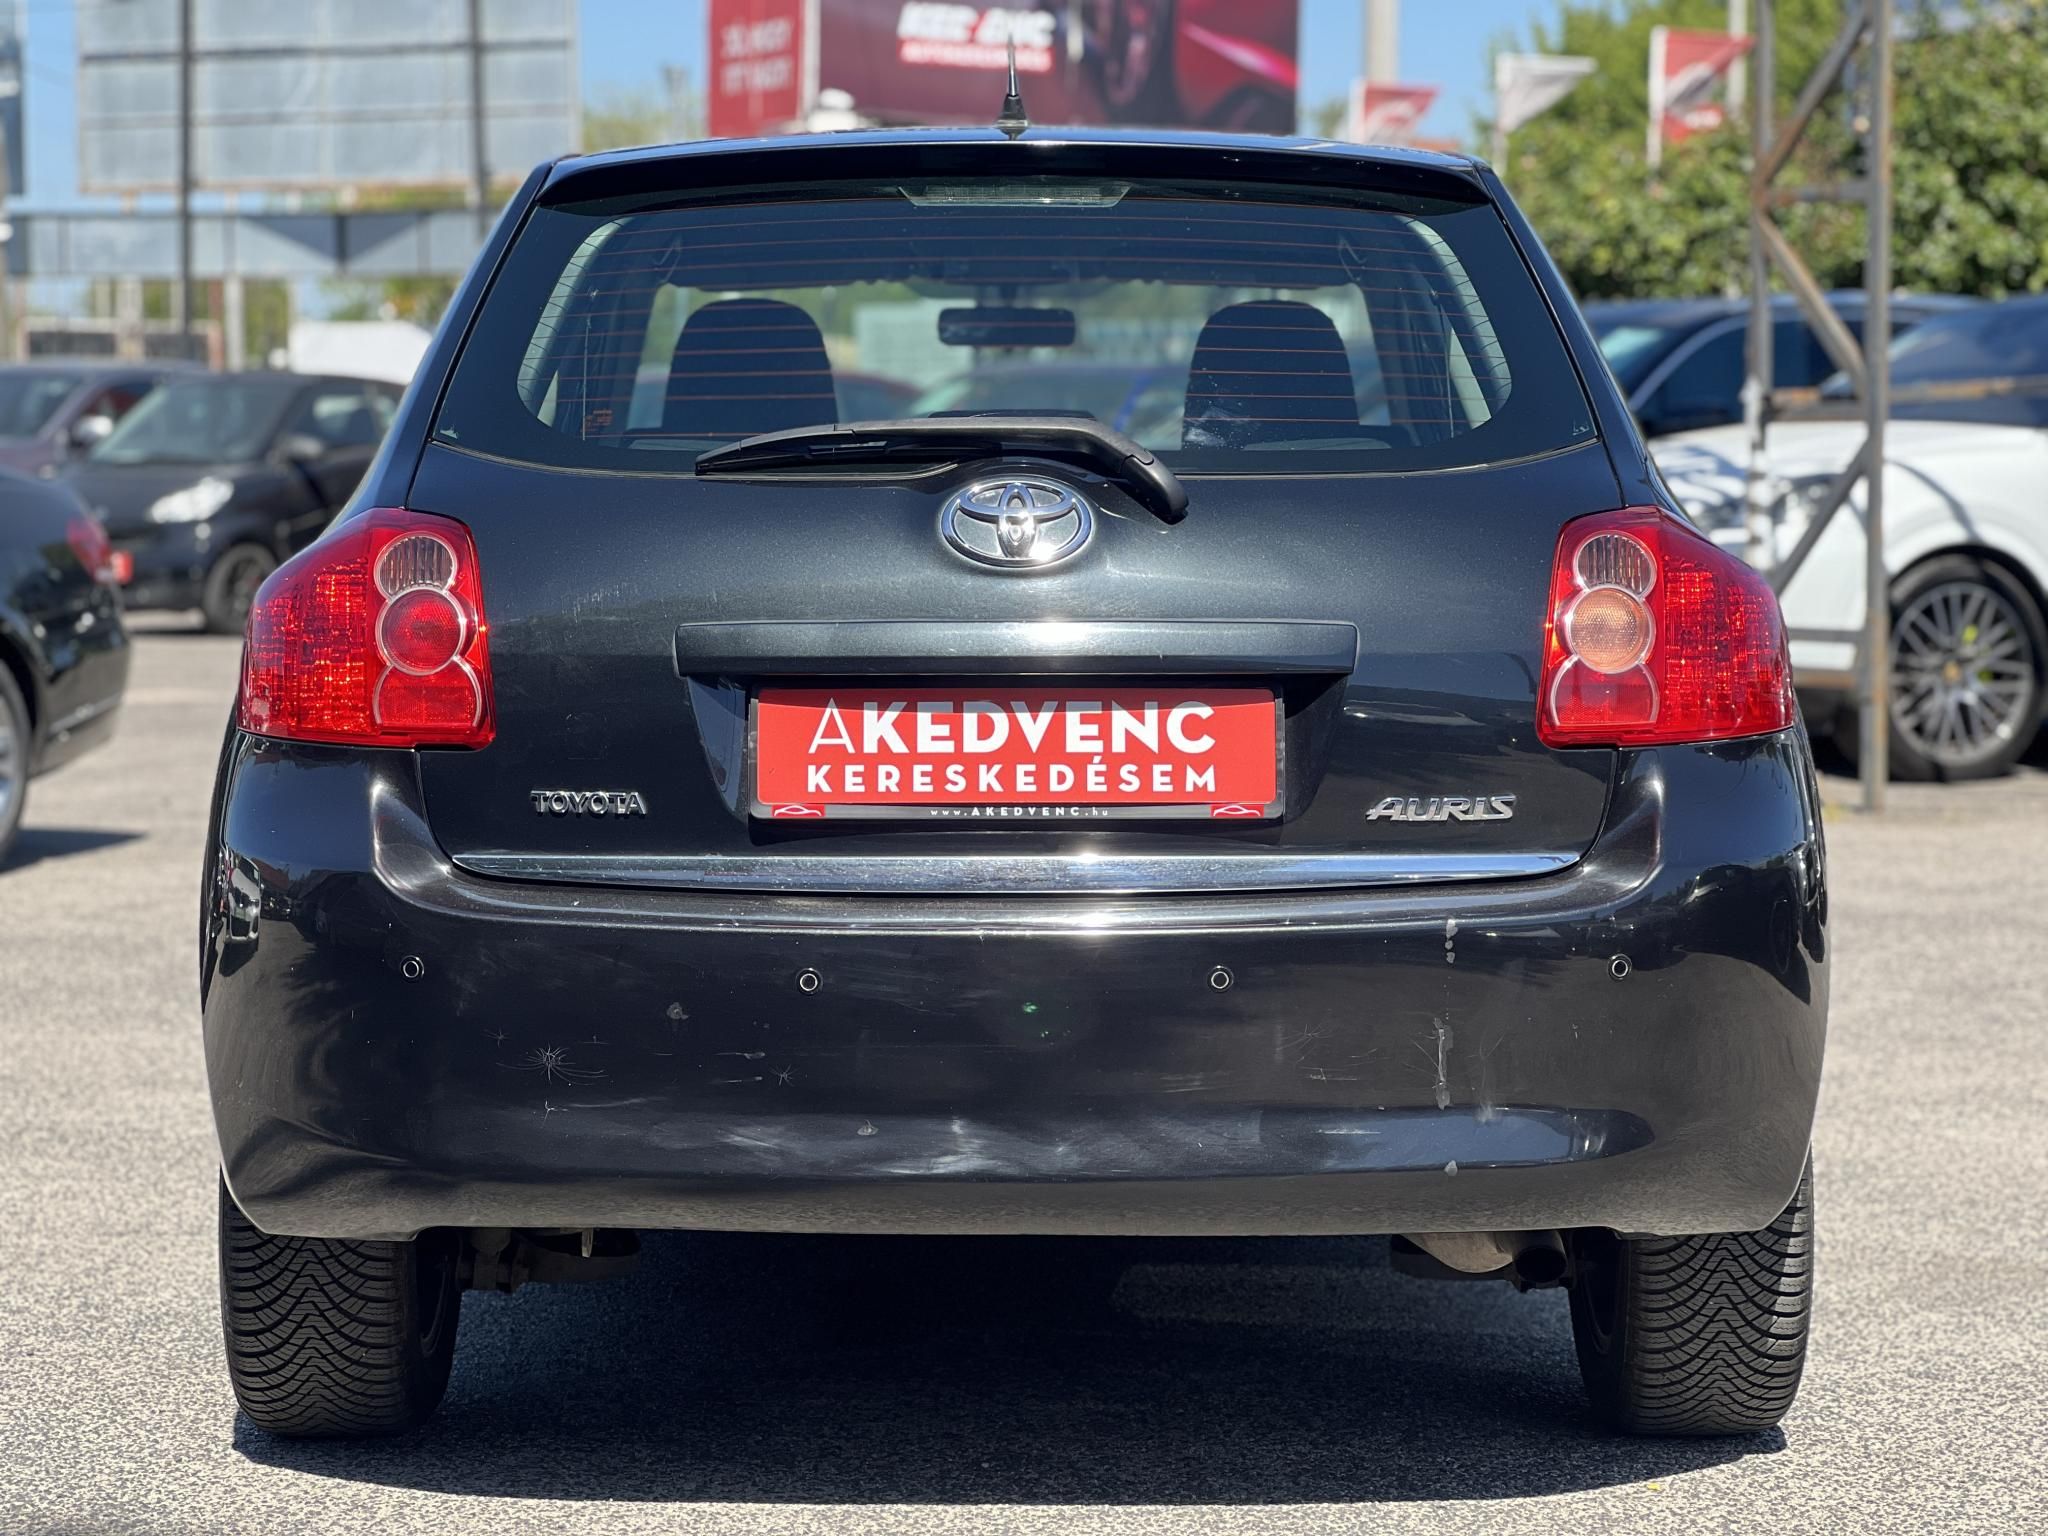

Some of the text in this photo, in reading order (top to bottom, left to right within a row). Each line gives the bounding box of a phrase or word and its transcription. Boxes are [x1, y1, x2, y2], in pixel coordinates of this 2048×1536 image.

[808, 697, 1216, 754] AKEDVENC
[806, 755, 1216, 794] KERESKEDÉSEM
[531, 790, 646, 815] TOYOTA
[930, 806, 1108, 817] www.AKEDVENC.hu
[1365, 794, 1516, 822] AURIS
